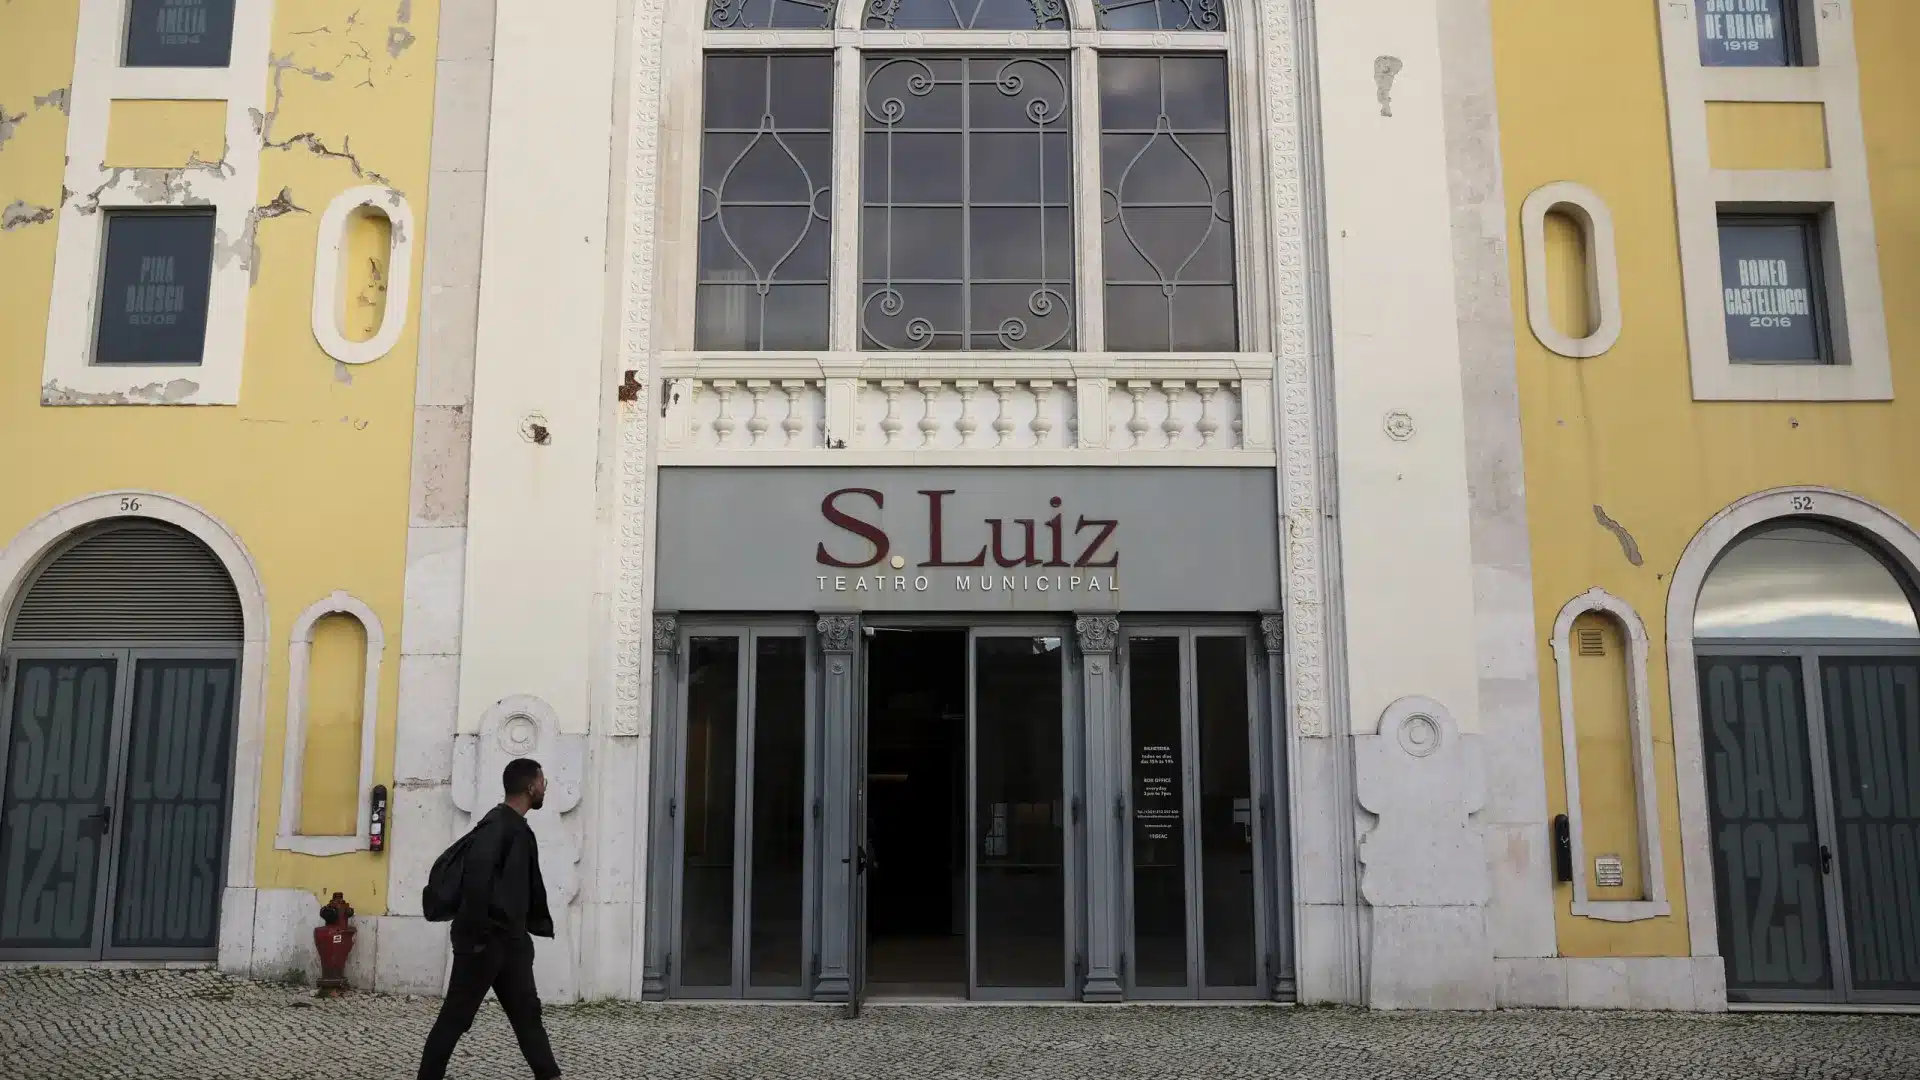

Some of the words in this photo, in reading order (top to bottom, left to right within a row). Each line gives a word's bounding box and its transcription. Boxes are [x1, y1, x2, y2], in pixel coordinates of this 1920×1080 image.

[1705, 14, 1723, 39] DE
[1726, 14, 1774, 39] BRAGA
[1723, 40, 1759, 50] 1918
[140, 256, 175, 284] PINA
[1738, 259, 1788, 286] ROMEO
[1725, 288, 1809, 315] CASTELLUCCI
[1749, 316, 1792, 327] 2016
[120, 497, 140, 512] 56
[1794, 496, 1812, 510] 52
[816, 576, 929, 591] TEATRO
[955, 576, 1120, 591] MUNICIPAL
[12, 666, 109, 800] SÃO
[129, 667, 230, 800] LUIZ
[1709, 664, 1804, 820] SÃO
[2, 802, 98, 939] 125
[119, 803, 219, 939] ANOS
[1719, 823, 1824, 983] 125
[1845, 823, 1920, 983] ANO
